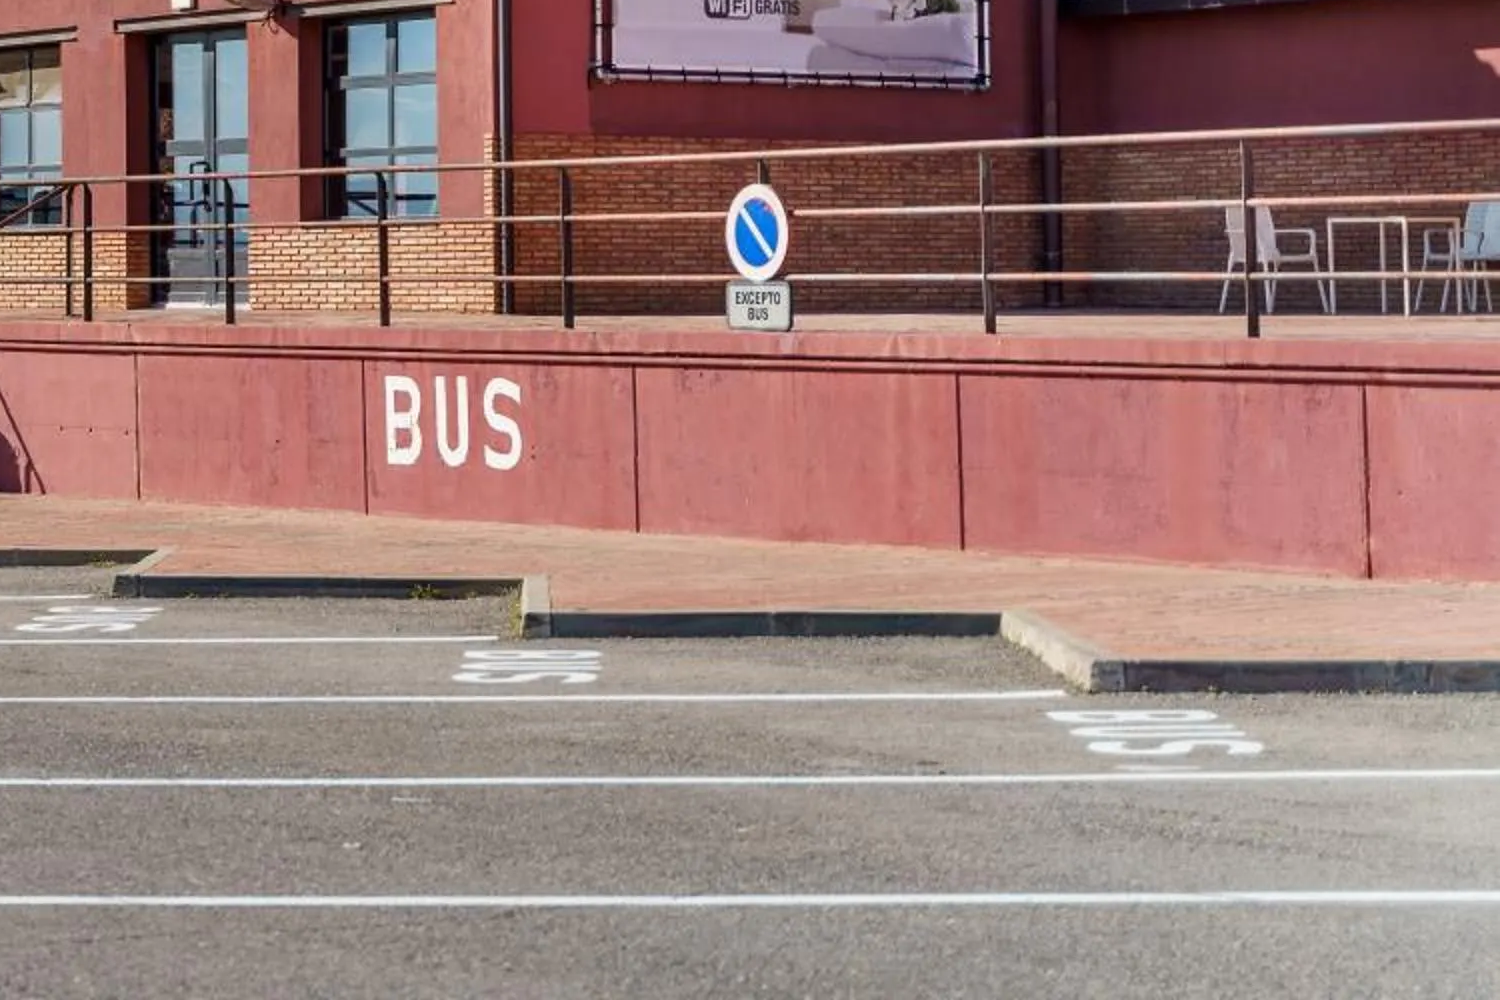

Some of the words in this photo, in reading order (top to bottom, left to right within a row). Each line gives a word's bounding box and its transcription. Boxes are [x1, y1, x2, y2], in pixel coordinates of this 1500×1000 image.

[755, 0, 800, 17] GRATIS
[735, 291, 781, 305] EXCEPTO
[747, 307, 769, 321] BUS
[384, 375, 523, 471] BUS
[451, 650, 604, 685] BUS
[1046, 709, 1265, 755] BUS
